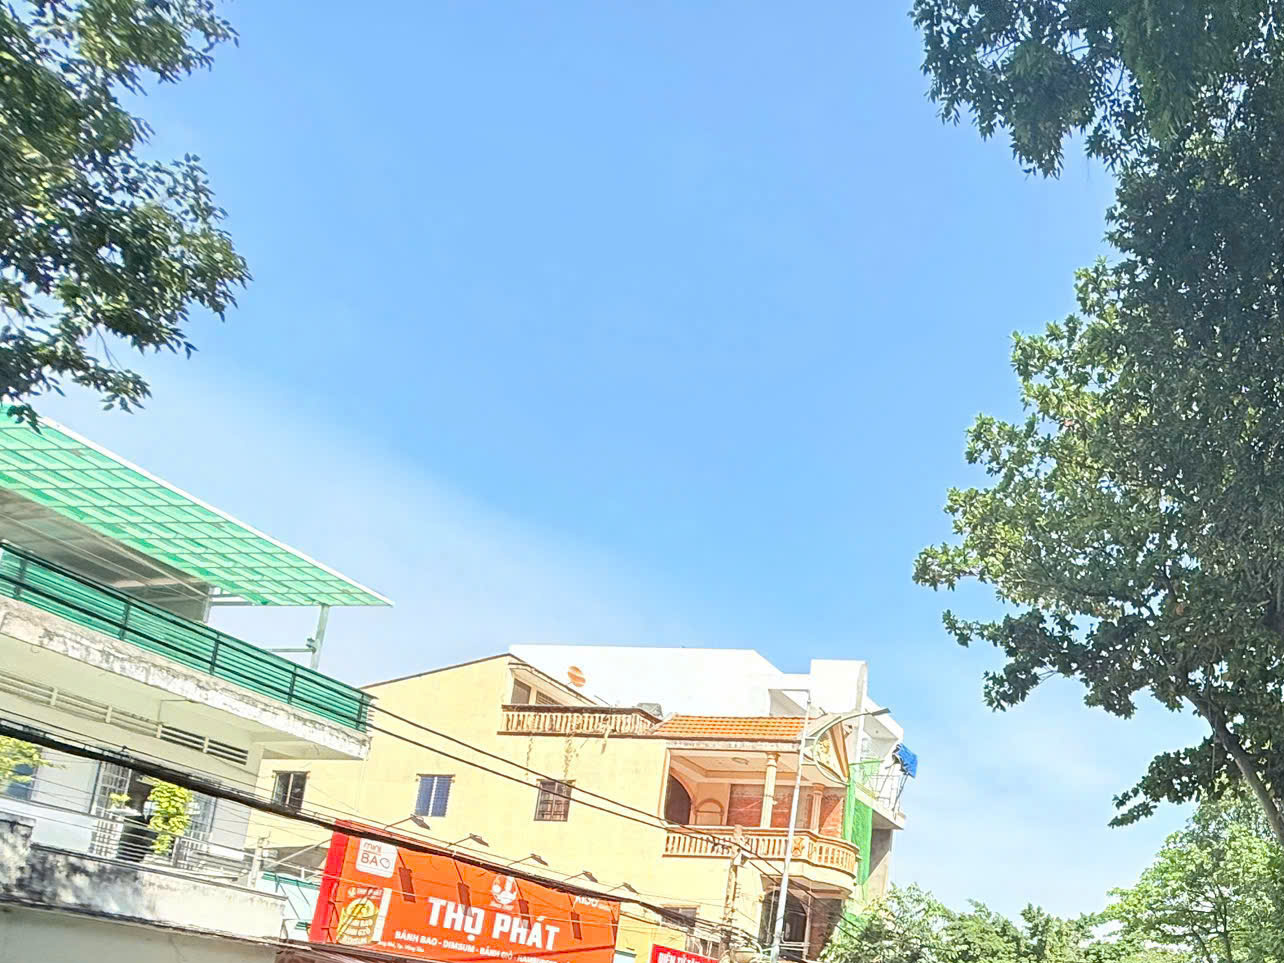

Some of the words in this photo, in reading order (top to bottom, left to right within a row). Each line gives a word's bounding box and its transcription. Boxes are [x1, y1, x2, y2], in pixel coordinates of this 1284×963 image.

[394, 929, 419, 944] BÁNH
[420, 934, 437, 946] BAO
[443, 939, 475, 954] DIMSUM
[428, 896, 485, 942] THỌ
[492, 915, 561, 951] PHÁT
